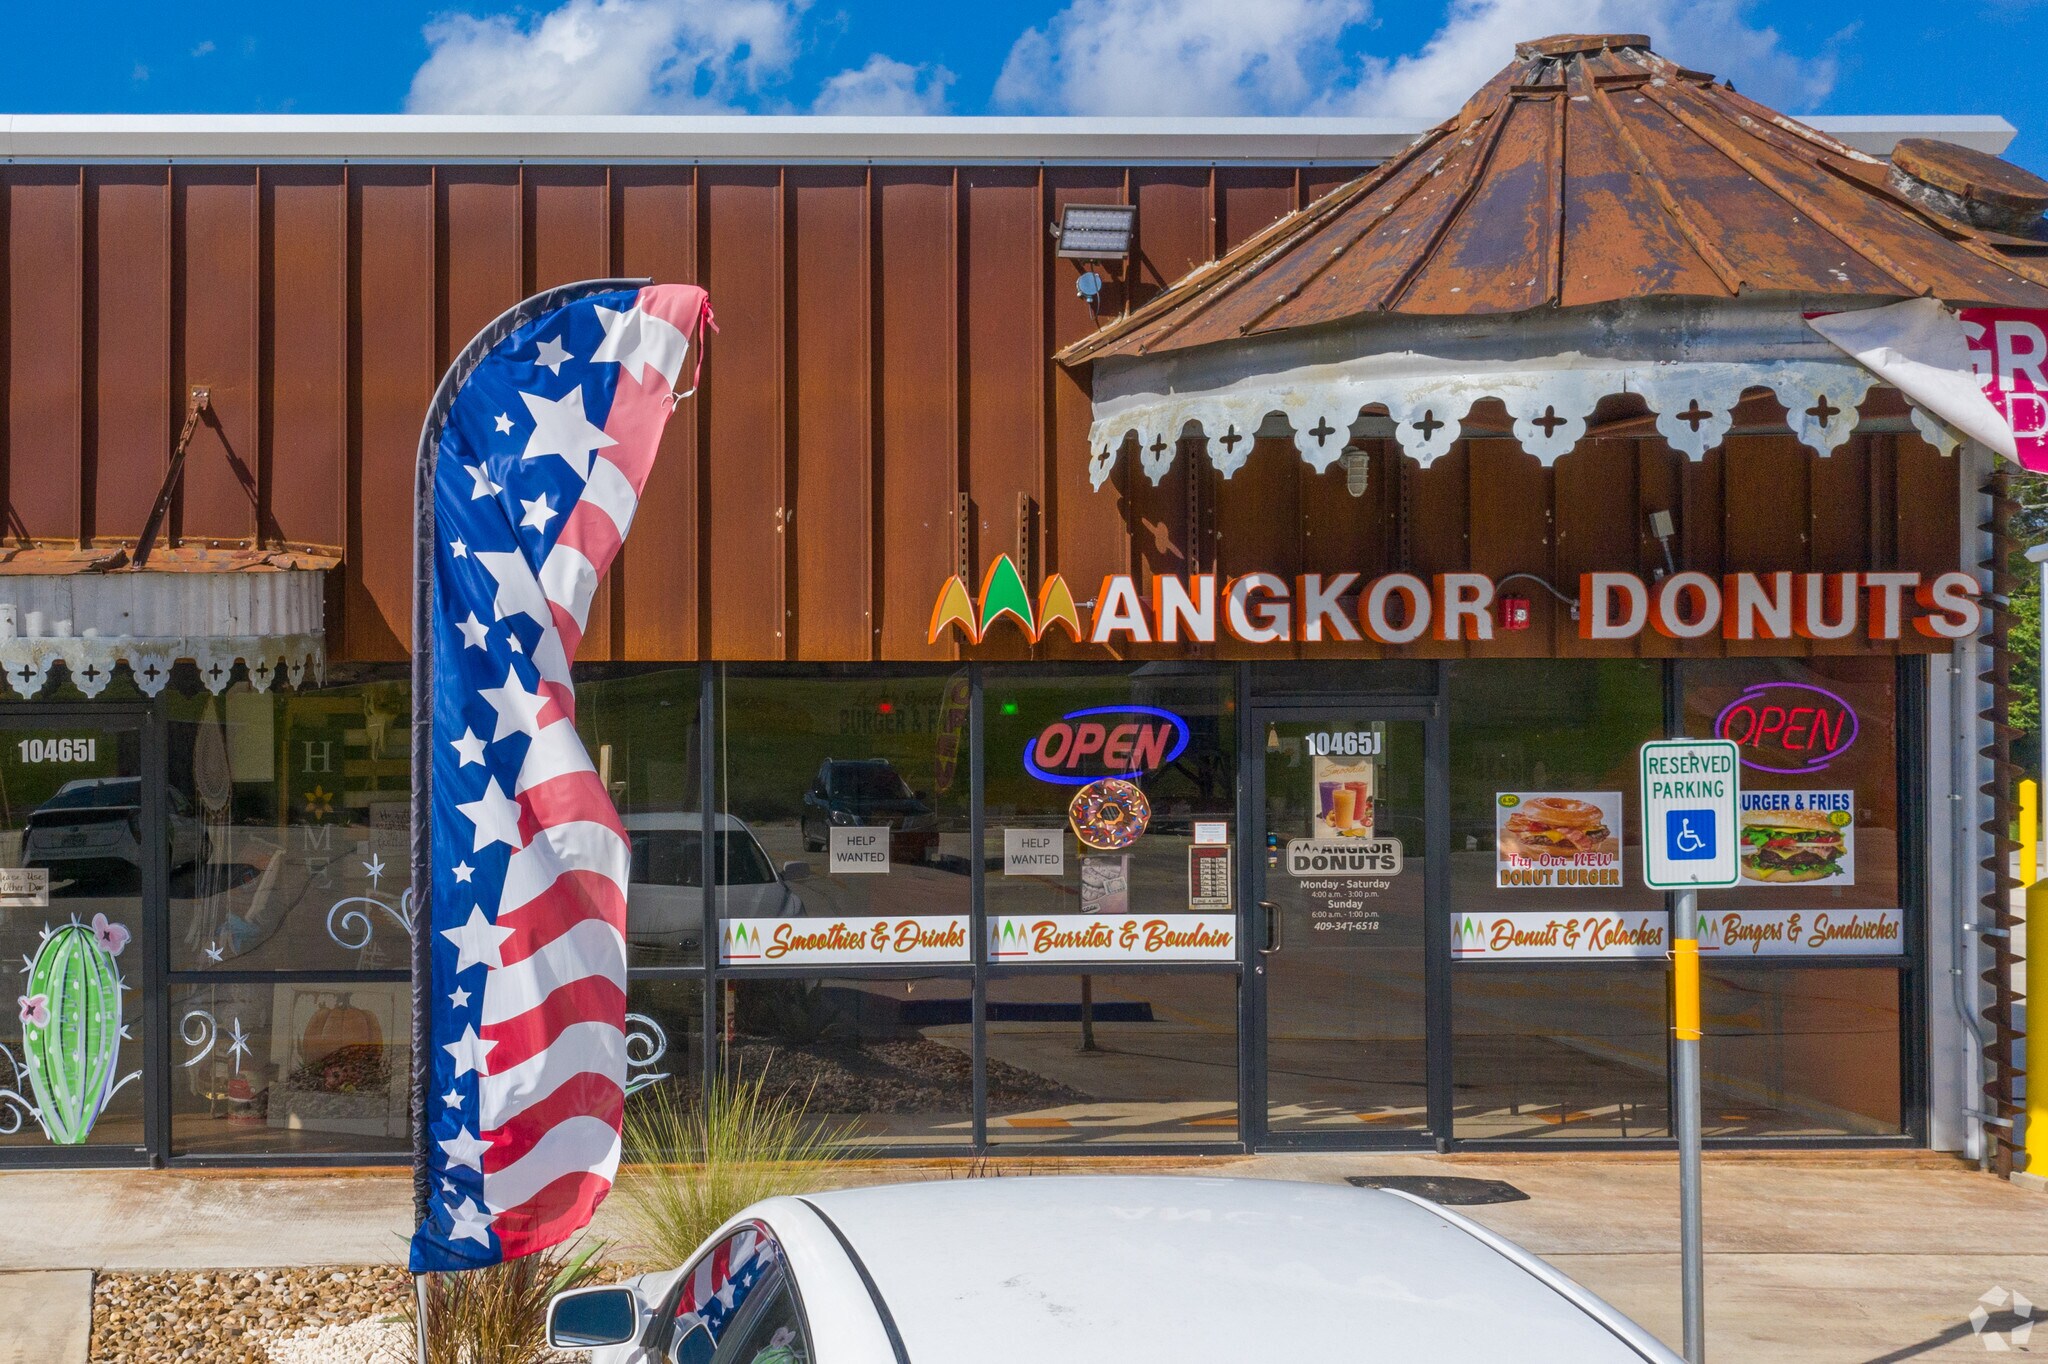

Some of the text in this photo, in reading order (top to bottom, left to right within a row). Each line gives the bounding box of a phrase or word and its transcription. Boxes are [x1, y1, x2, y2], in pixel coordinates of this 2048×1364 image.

[1089, 571, 1982, 644] ANGKOR DONUTS
[1723, 705, 1846, 751] OPEN
[1035, 722, 1172, 770] OPEN
[1649, 755, 1731, 774] RESERVED
[1653, 780, 1725, 799] PARKING
[1740, 793, 1850, 811] URGER & FRIES
[847, 836, 876, 846] HELP
[1021, 838, 1050, 848] HELP
[836, 852, 886, 862] WANTED
[1011, 854, 1060, 864] WANTED
[1294, 855, 1396, 871] DONUTS
[1510, 853, 1614, 869] Try Our NEW
[1300, 879, 1339, 890] Monday
[1346, 879, 1391, 890] Saturday
[1500, 868, 1620, 886] DONUT BURGER
[1327, 900, 1363, 910] Sunday
[1314, 921, 1380, 931] 409-347-6518
[1490, 917, 1664, 951] Donuts & Kolaches
[1722, 912, 1900, 954] Burgers & Sandwiches
[765, 920, 967, 959] Smoothies & Drinks
[1031, 919, 1233, 954] Burritos & Boudain
